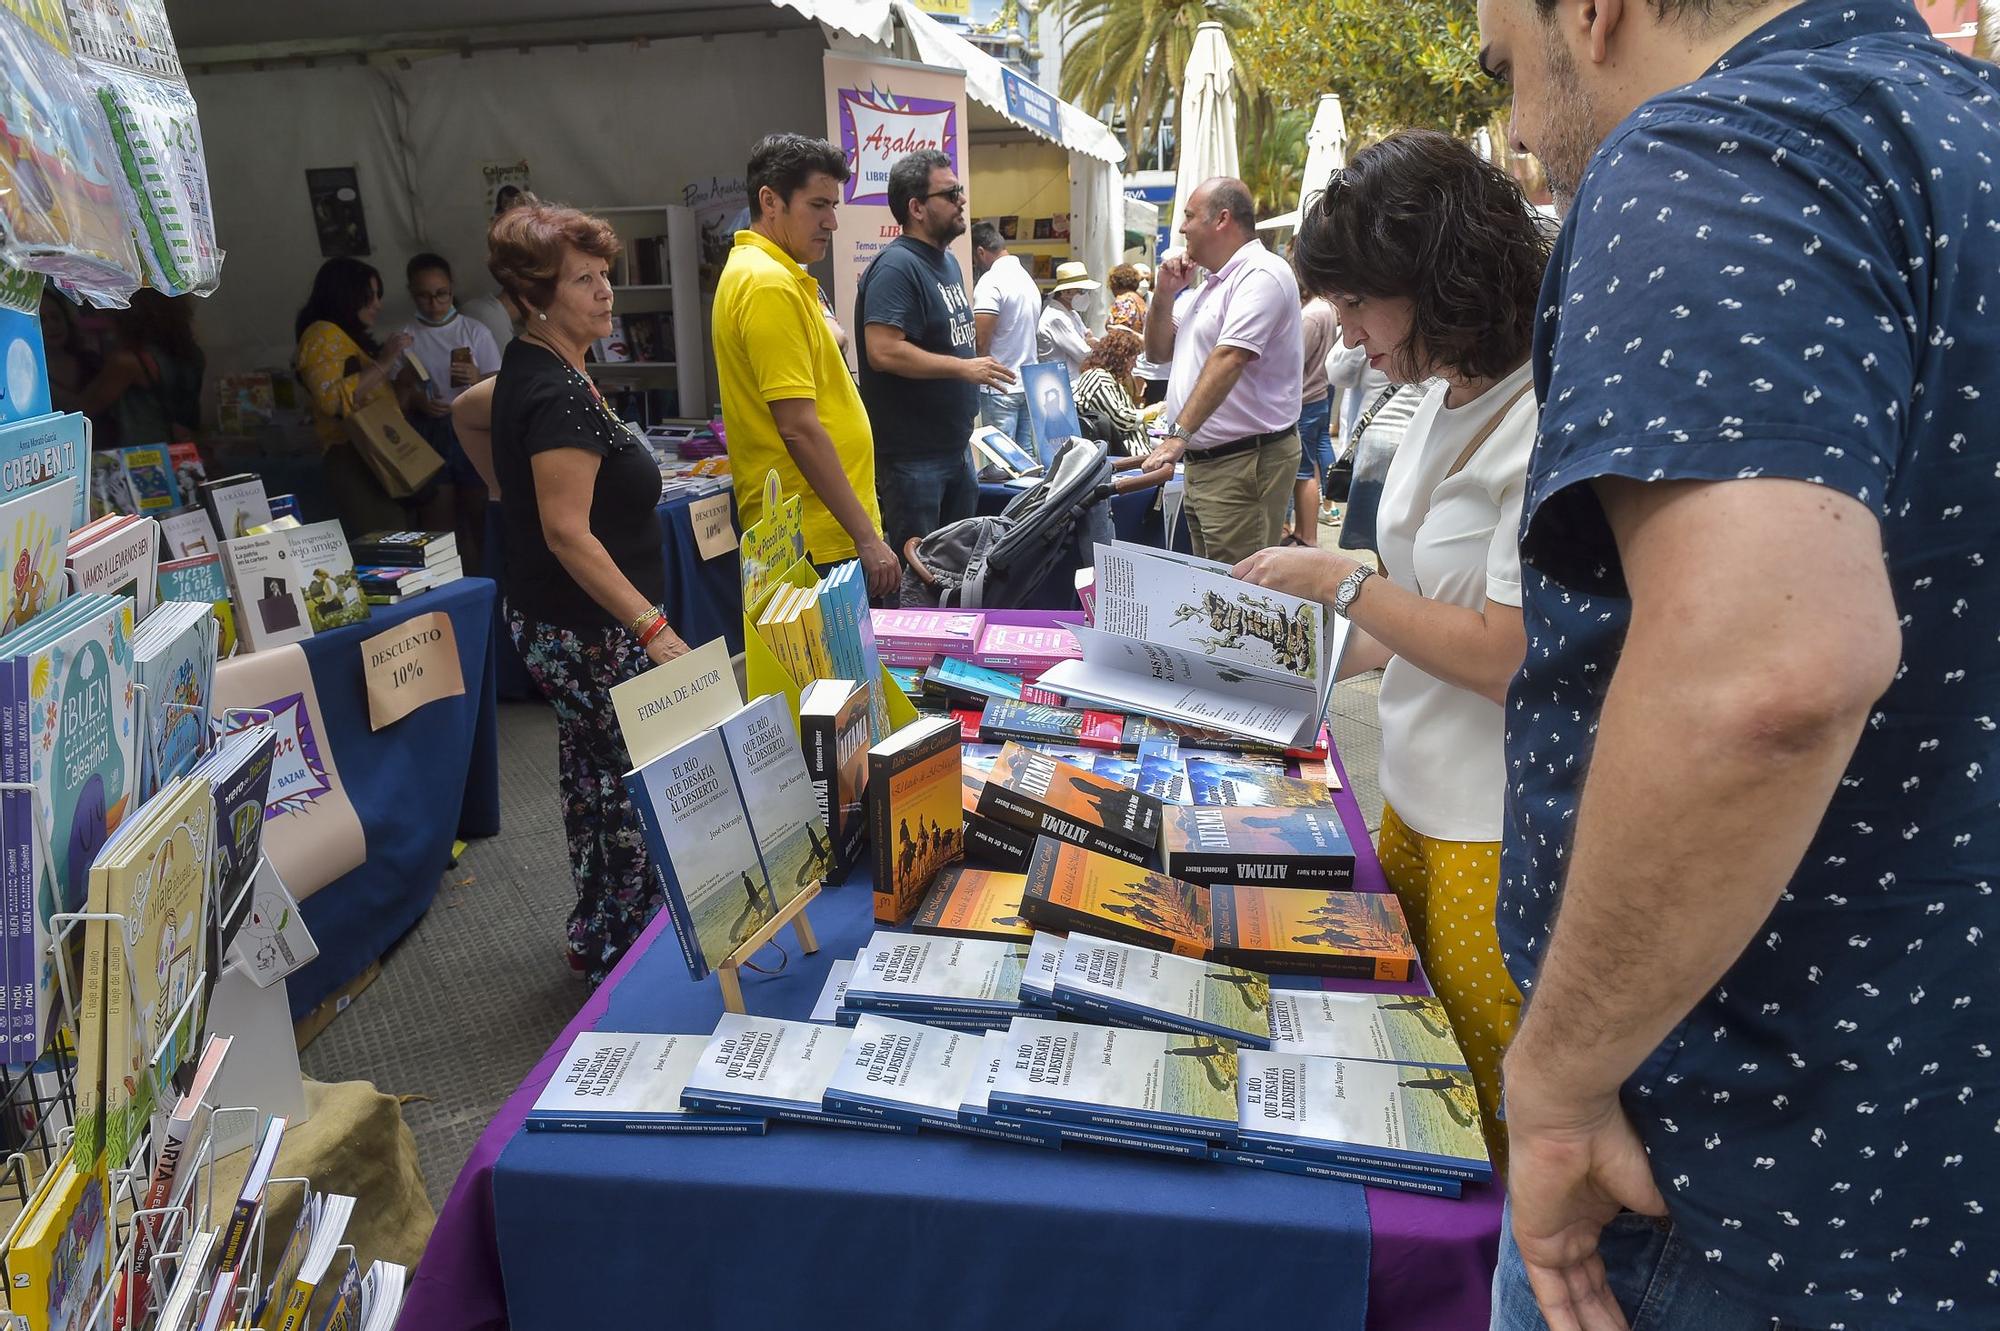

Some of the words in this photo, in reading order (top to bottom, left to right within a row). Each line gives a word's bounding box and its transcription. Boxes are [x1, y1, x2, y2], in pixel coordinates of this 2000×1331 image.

[862, 124, 936, 160] Azahar
[866, 171, 889, 182] LIBRE
[879, 225, 901, 238] LIB
[2, 452, 41, 492] CREO
[44, 445, 63, 477] EN
[63, 441, 76, 471] TI
[695, 504, 728, 521] DESCUENTO
[705, 522, 721, 539] 10%
[82, 567, 103, 589] VAMOS
[108, 544, 138, 577] LLEVARNOS
[371, 629, 442, 668] DESCUENTO
[393, 659, 424, 689] 10%
[637, 695, 674, 722] FIRMA
[673, 685, 690, 704] DE
[691, 669, 721, 695] AUTOR
[747, 724, 756, 736] EL
[756, 716, 769, 732] RÍO
[742, 738, 757, 756] QUE
[756, 722, 783, 747] DESAFÍA
[840, 714, 868, 770] AITAMA
[746, 754, 755, 768] AL
[755, 736, 786, 764] DESIERTO
[64, 733, 109, 791] Celestino!
[672, 766, 684, 780] EL
[683, 756, 699, 774] RÍO
[277, 769, 306, 788] BAZAR
[665, 782, 684, 801] QUE
[682, 764, 715, 791] DESAFÍA
[779, 781, 789, 793] José
[788, 769, 807, 787] Naranjo
[1019, 754, 1057, 798] AITAMA
[671, 802, 682, 815] AL
[681, 778, 719, 811] DESIERTO
[709, 828, 722, 841] José
[721, 814, 743, 832] Naranjo
[1041, 813, 1090, 844] AITAMA
[1194, 809, 1231, 849] AITAMA
[993, 838, 1002, 847] de
[1007, 845, 1023, 857] Jorge
[1114, 847, 1122, 856] de
[1128, 851, 1144, 864] Jorge
[1237, 863, 1288, 879] AITAMA
[1319, 869, 1326, 877] de
[1334, 868, 1350, 877] Jorge
[13, 985, 22, 1010] miau
[25, 983, 34, 1008] miau
[720, 1039, 738, 1054] RÍO
[734, 1031, 758, 1061] DESAFÍA
[806, 1026, 822, 1049] Naranjo
[1104, 1030, 1117, 1053] Naranjo
[659, 1036, 677, 1060] Naranjo
[746, 1032, 773, 1069] DESIERTO
[801, 1048, 812, 1061] José
[860, 1042, 877, 1059] RÍO
[873, 1033, 897, 1065] DESAFÍA
[887, 1035, 912, 1074] DESIERTO
[941, 1053, 952, 1068] José
[947, 1033, 961, 1055] Naranjo
[1017, 1044, 1034, 1059] RÍO
[1032, 1035, 1052, 1066] DESAFÍA
[1047, 1036, 1068, 1074] DESIERTO
[572, 1058, 590, 1072] RÍO
[596, 1047, 627, 1085] DESIERTO
[653, 1058, 666, 1072] José
[715, 1055, 731, 1065] EL
[856, 1059, 871, 1068] EL
[1015, 1061, 1029, 1070] EL
[1102, 1051, 1112, 1066] José
[566, 1075, 581, 1084] EL
[574, 1080, 594, 1096] QUE
[584, 1046, 612, 1078] DESAFÍA
[725, 1062, 744, 1079] QUE
[742, 1071, 757, 1081] AL
[866, 1063, 883, 1082] QUE
[882, 1072, 898, 1086] AL
[1028, 1064, 1046, 1083] QUE
[1045, 1072, 1060, 1086] AL
[1334, 1062, 1345, 1084] Naranjo
[590, 1085, 606, 1097] AL
[1245, 1077, 1262, 1092] RÍO
[1262, 1067, 1279, 1100] DESAFÍA
[1281, 1068, 1296, 1108] DESIERTO
[1335, 1084, 1346, 1099] José
[1248, 1092, 1261, 1105] EL
[1264, 1101, 1281, 1119] QUE
[1281, 1108, 1296, 1121] AL
[156, 1134, 183, 1183] ARTA
[154, 1184, 165, 1197] EN
[13, 1273, 31, 1288] 2
